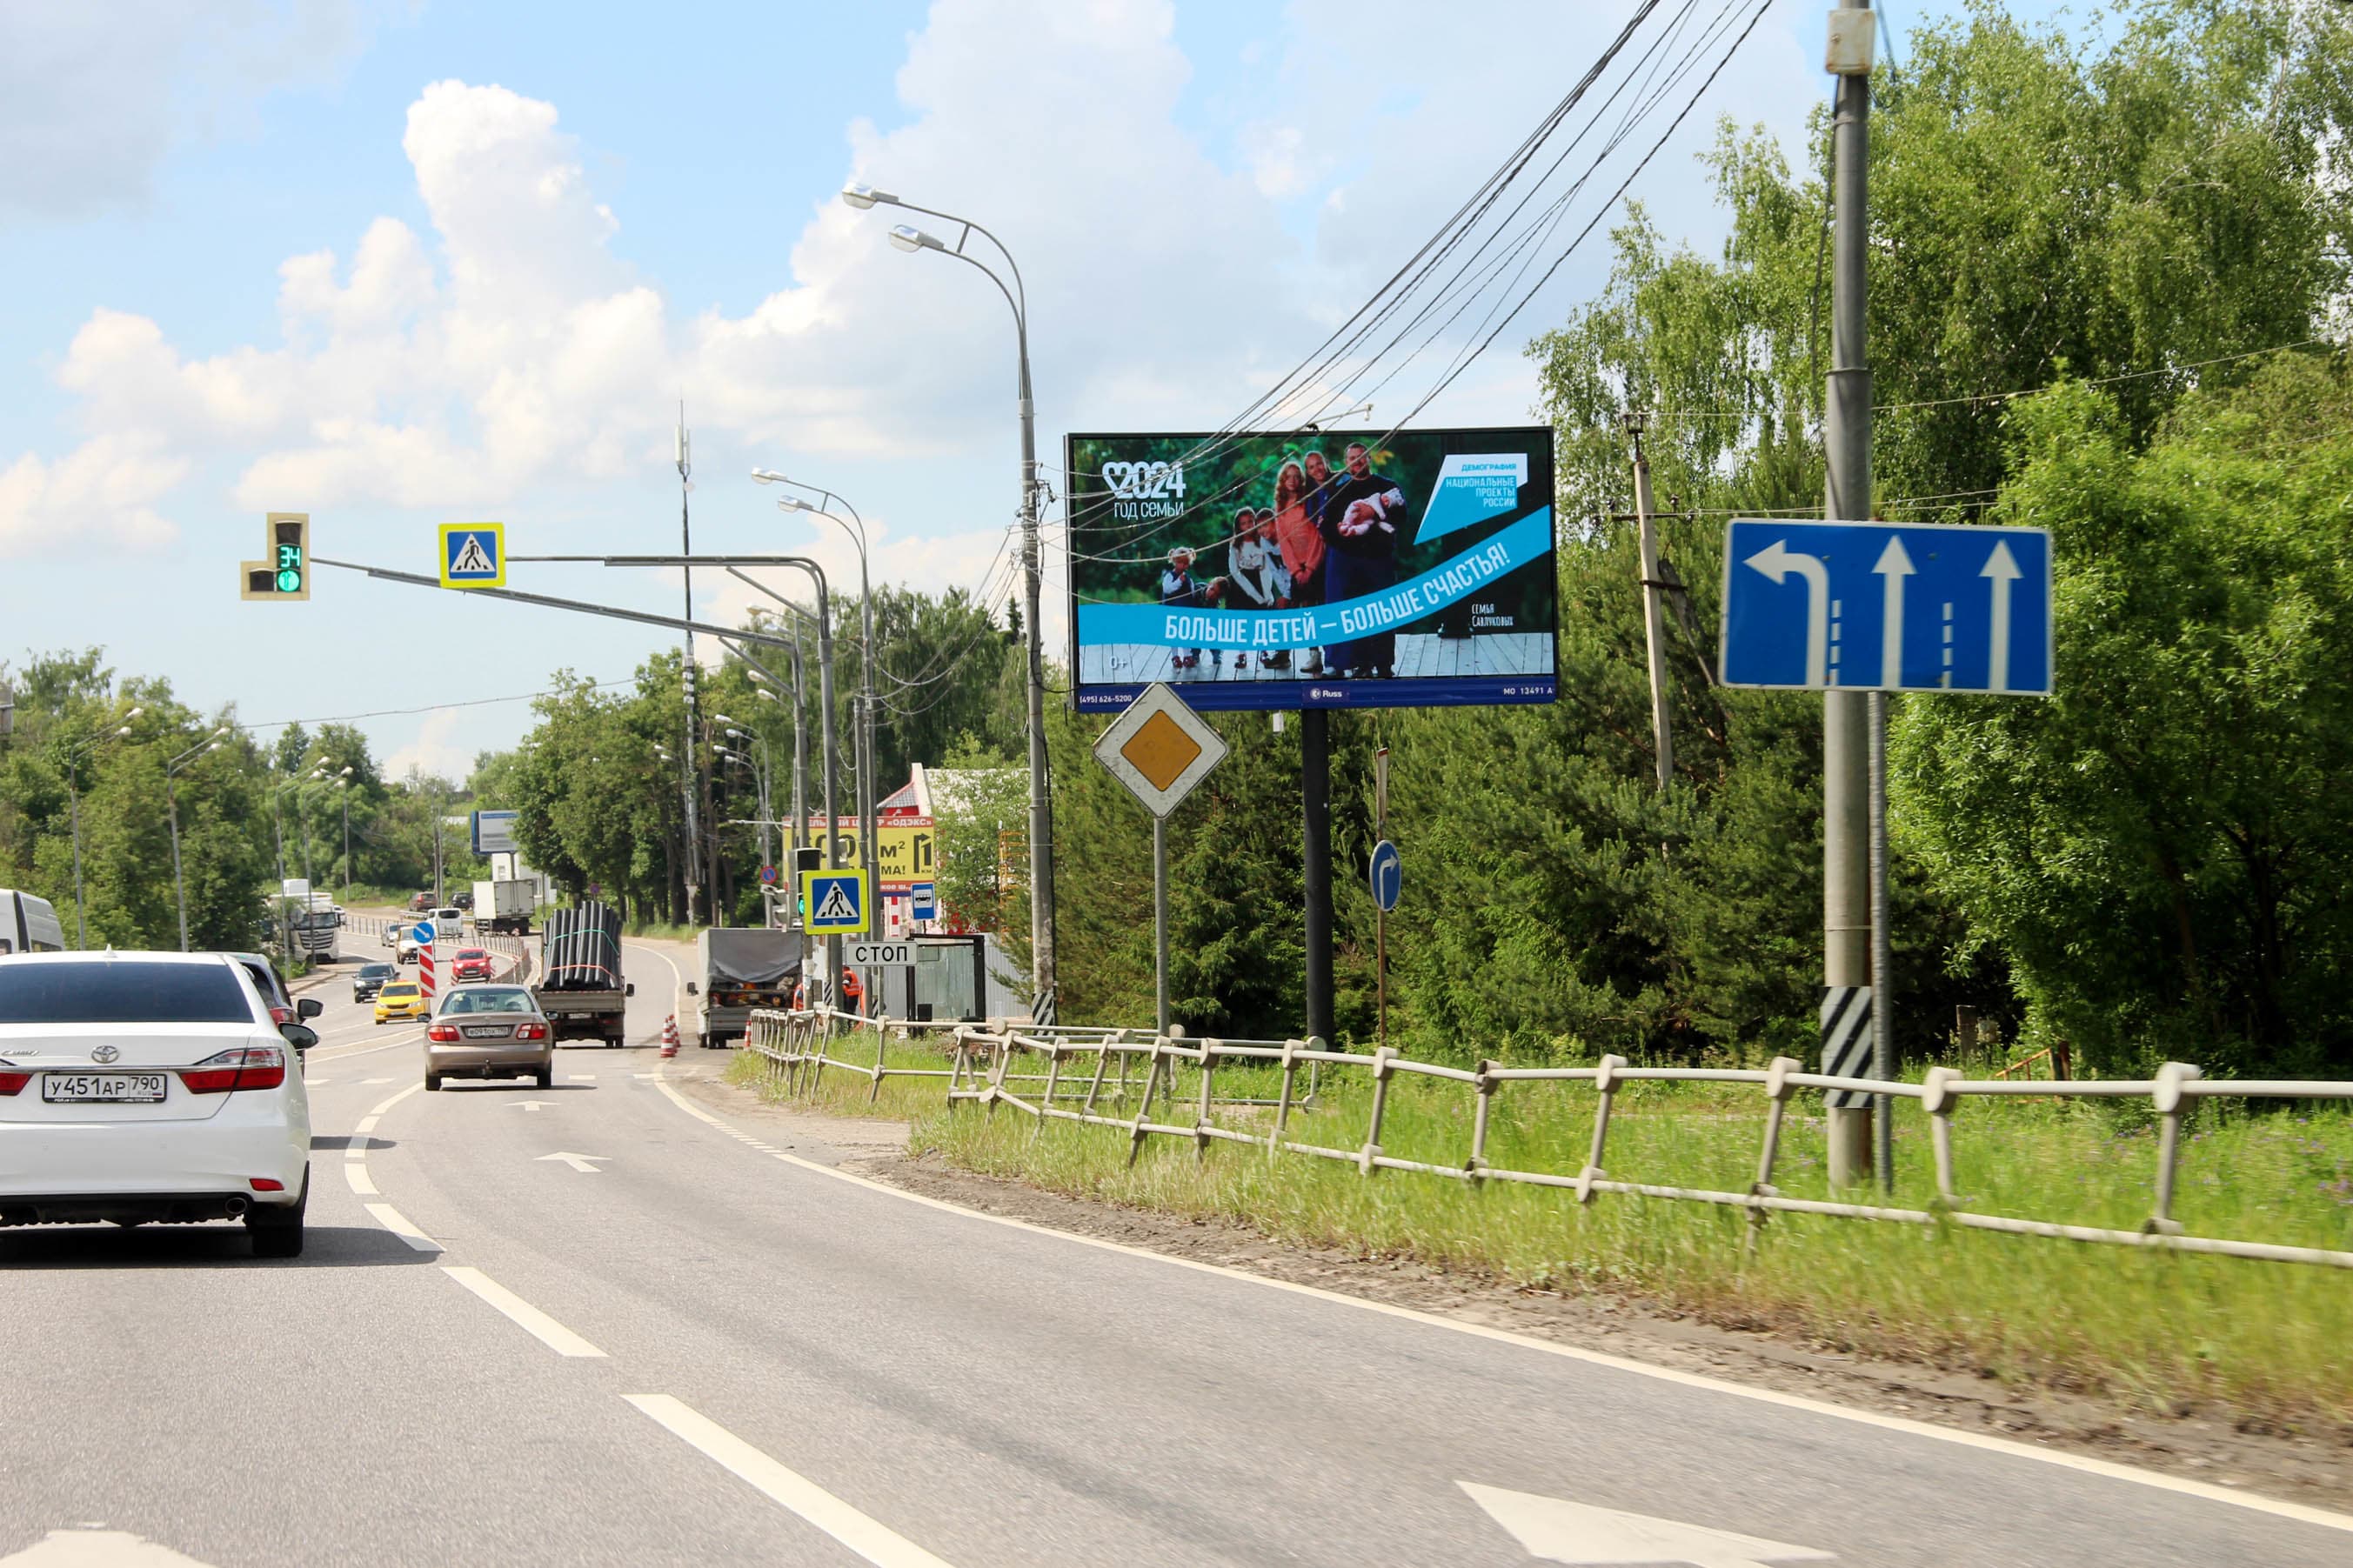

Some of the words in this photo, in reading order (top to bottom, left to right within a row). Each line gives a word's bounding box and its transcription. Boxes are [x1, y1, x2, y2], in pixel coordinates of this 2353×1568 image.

[1461, 463, 1517, 471] ДЕМОГРАФИЯ
[1115, 461, 1187, 499] 2024
[1446, 477, 1515, 488] НАЦИОНАЛЬНЫЕ
[1475, 487, 1515, 497] ПРОЕКТЫ
[1482, 497, 1516, 508] РОССИИ
[1114, 502, 1139, 521] ГОД
[280, 546, 301, 568] 34
[1165, 614, 1247, 643] БОЛЬШЕ
[1253, 611, 1317, 646] ДЕТЕЙ
[1342, 588, 1425, 635] БОЛЬШЕ
[1422, 542, 1512, 606] СЧАСТЬЯ!
[1109, 656, 1128, 670] 0+
[1080, 695, 1098, 704] (495)
[887, 818, 933, 828] «ОДЭКС»
[856, 946, 907, 963] СТОП
[52, 1078, 126, 1096] У451АР
[130, 1077, 159, 1091] 790
